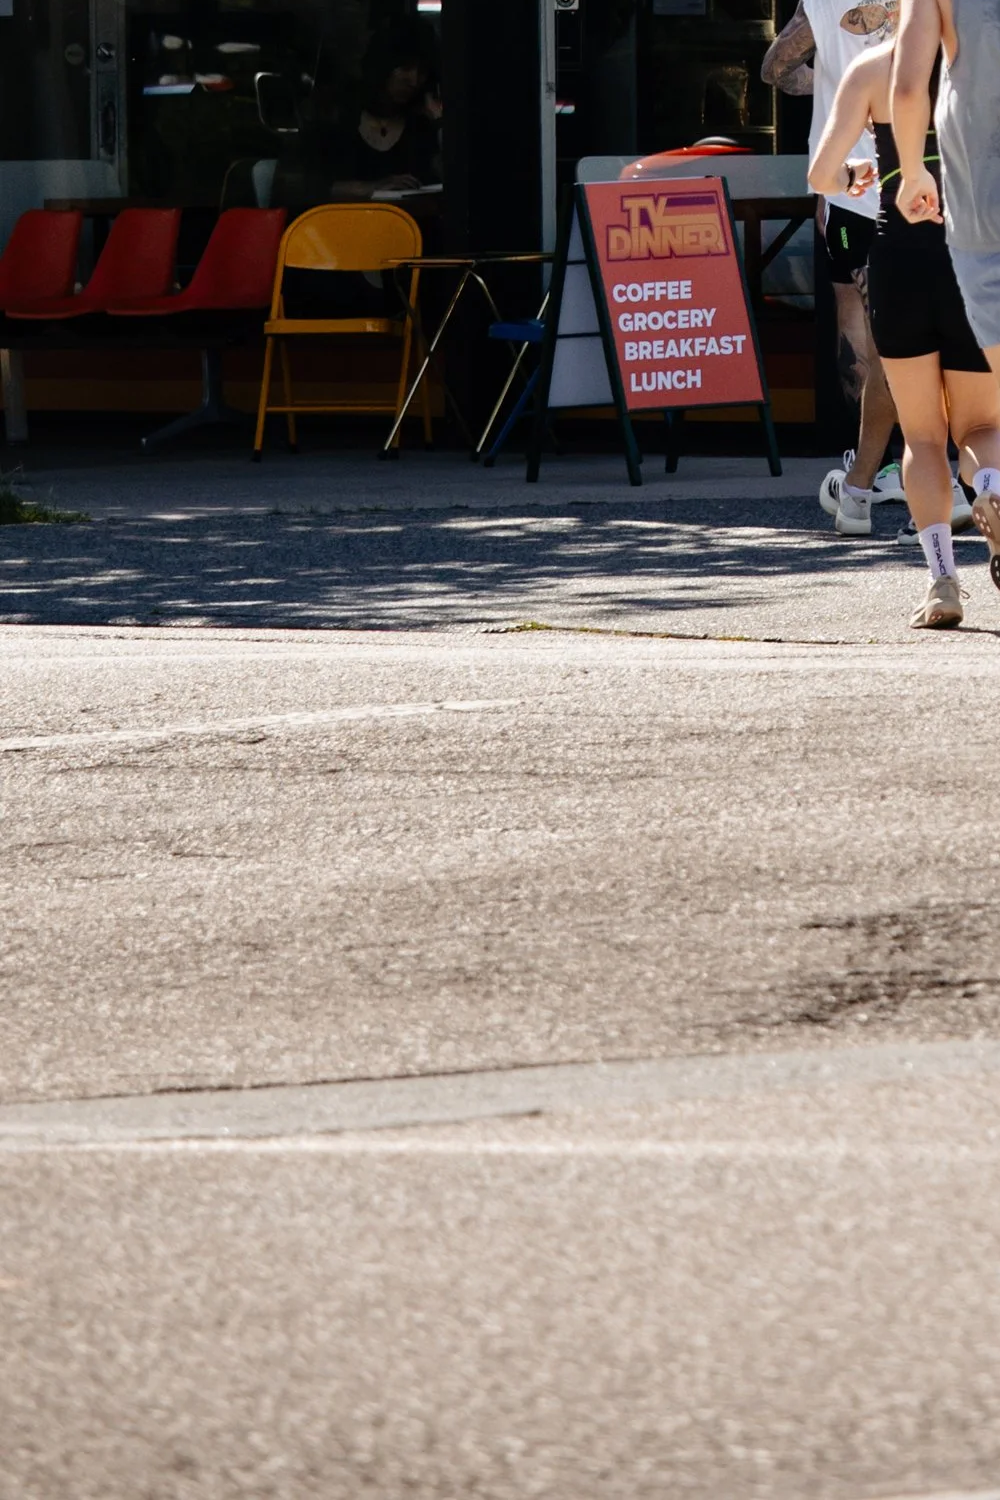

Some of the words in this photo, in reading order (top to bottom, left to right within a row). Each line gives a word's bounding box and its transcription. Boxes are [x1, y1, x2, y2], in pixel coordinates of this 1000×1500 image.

[622, 195, 669, 228] TV
[607, 224, 727, 261] DINNER
[612, 280, 692, 303] COFFEE
[618, 308, 716, 332] GROCERY
[624, 335, 746, 361] BREAKFAST
[631, 369, 702, 392] LUNCH
